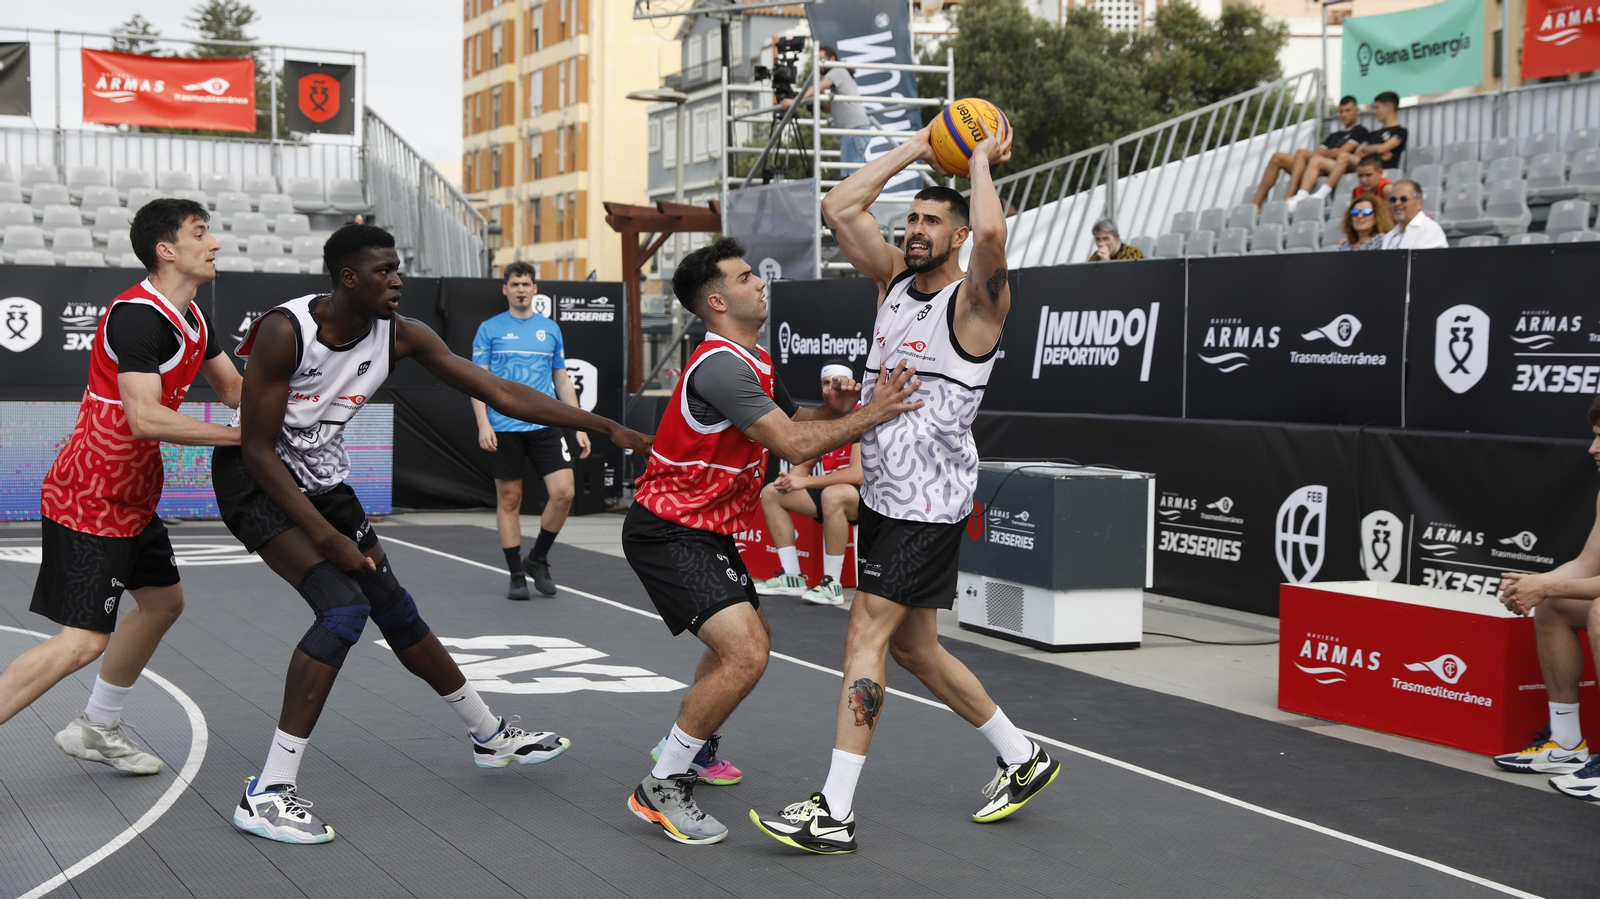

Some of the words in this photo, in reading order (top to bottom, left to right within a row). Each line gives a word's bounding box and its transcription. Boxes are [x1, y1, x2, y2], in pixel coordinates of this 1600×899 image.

[1374, 47, 1411, 67] Gana
[1411, 32, 1471, 60] Energía
[95, 76, 166, 93] ARMAS
[956, 103, 984, 143] molten
[63, 305, 108, 317] ARMA
[559, 311, 615, 322] 3X3SERIES
[1045, 308, 1147, 347] MUNDO
[1515, 315, 1583, 332] ARMAS
[791, 333, 820, 355] Gana
[821, 331, 868, 362] Energía
[1203, 325, 1282, 349] ARMAS
[1042, 346, 1120, 366] DEPORTIVO
[1289, 351, 1387, 366] Trasmediterránea
[1511, 364, 1600, 394] 3X3SE
[287, 388, 321, 403] RMAS
[1159, 495, 1198, 511] ARMAS
[1307, 491, 1323, 503] FEB
[989, 509, 1010, 519] ARMAS
[989, 530, 1035, 550] 3X3SERIES
[1158, 530, 1242, 562] 3X3SERIES
[1422, 526, 1485, 546] ARMAS
[1306, 632, 1340, 643] NAVIERA
[1299, 639, 1382, 672] ARMAS
[1391, 677, 1493, 707] Trasmediterránea
